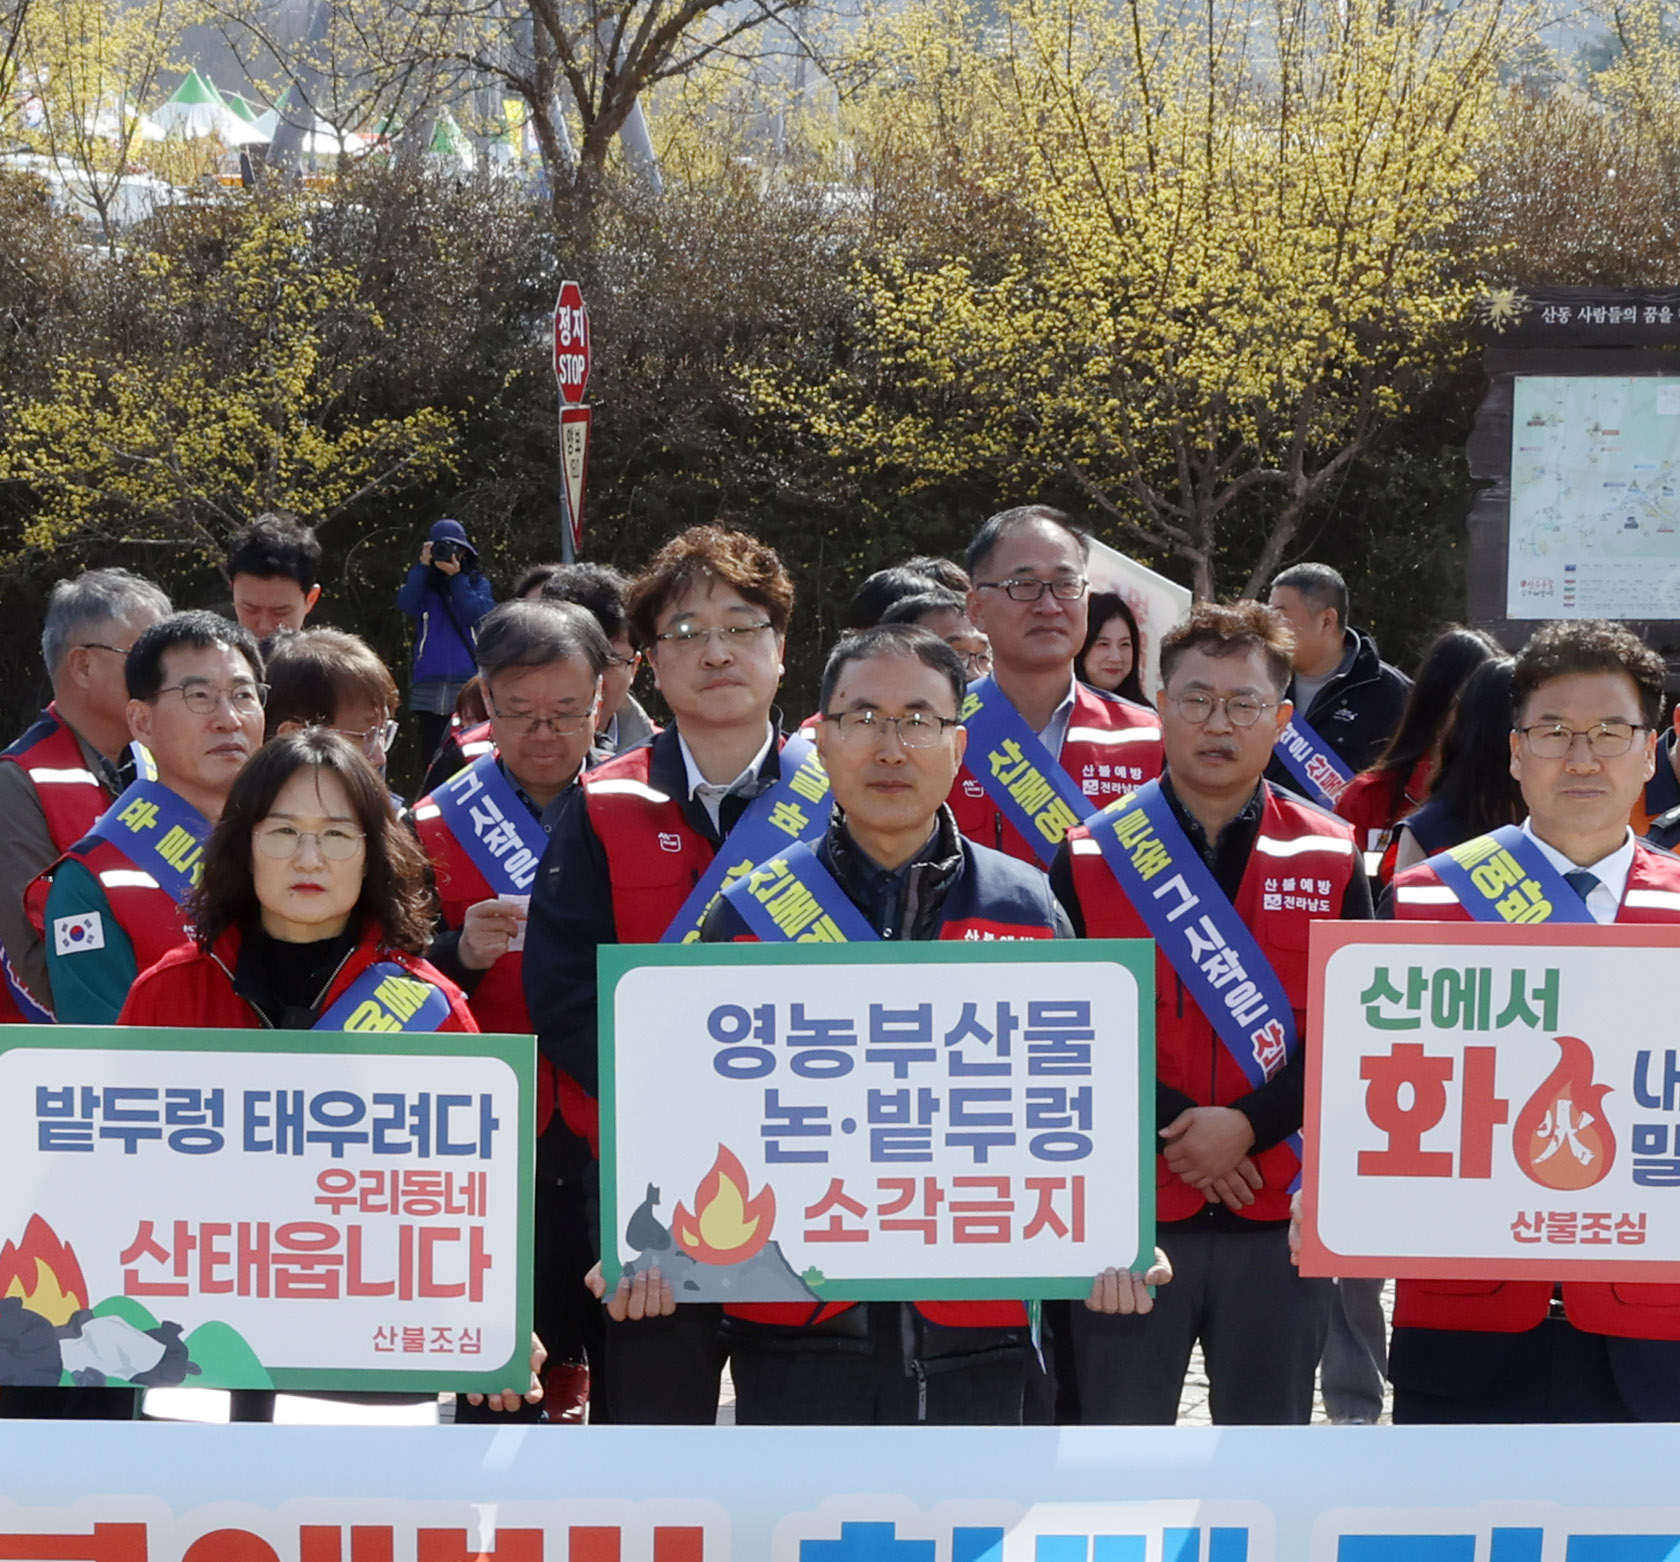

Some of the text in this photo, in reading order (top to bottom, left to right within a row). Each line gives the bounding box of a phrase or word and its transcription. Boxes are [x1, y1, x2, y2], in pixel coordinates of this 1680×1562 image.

[558, 305, 585, 346] 정지
[1541, 305, 1571, 324] 산동
[1577, 305, 1637, 324] 사람들의
[1643, 305, 1673, 324] 꿈을
[558, 354, 585, 384] STOP
[1082, 764, 1143, 781] 산불예방
[1264, 877, 1332, 896] 산불예방
[1283, 897, 1331, 913] 전라남도
[1183, 914, 1270, 1029] 시작은
[1359, 965, 1561, 1033] 산에서
[707, 999, 1097, 1081] 영농부산물
[34, 1084, 500, 1160] 밭두렁 태우려다
[1356, 1042, 1510, 1180] 화
[314, 1167, 488, 1218] 우리동네
[802, 1174, 1088, 1246] 소각금지
[1510, 1211, 1648, 1245] 산불조심
[118, 1218, 493, 1304] 산태웁니다
[371, 1324, 483, 1356] 산불조심
